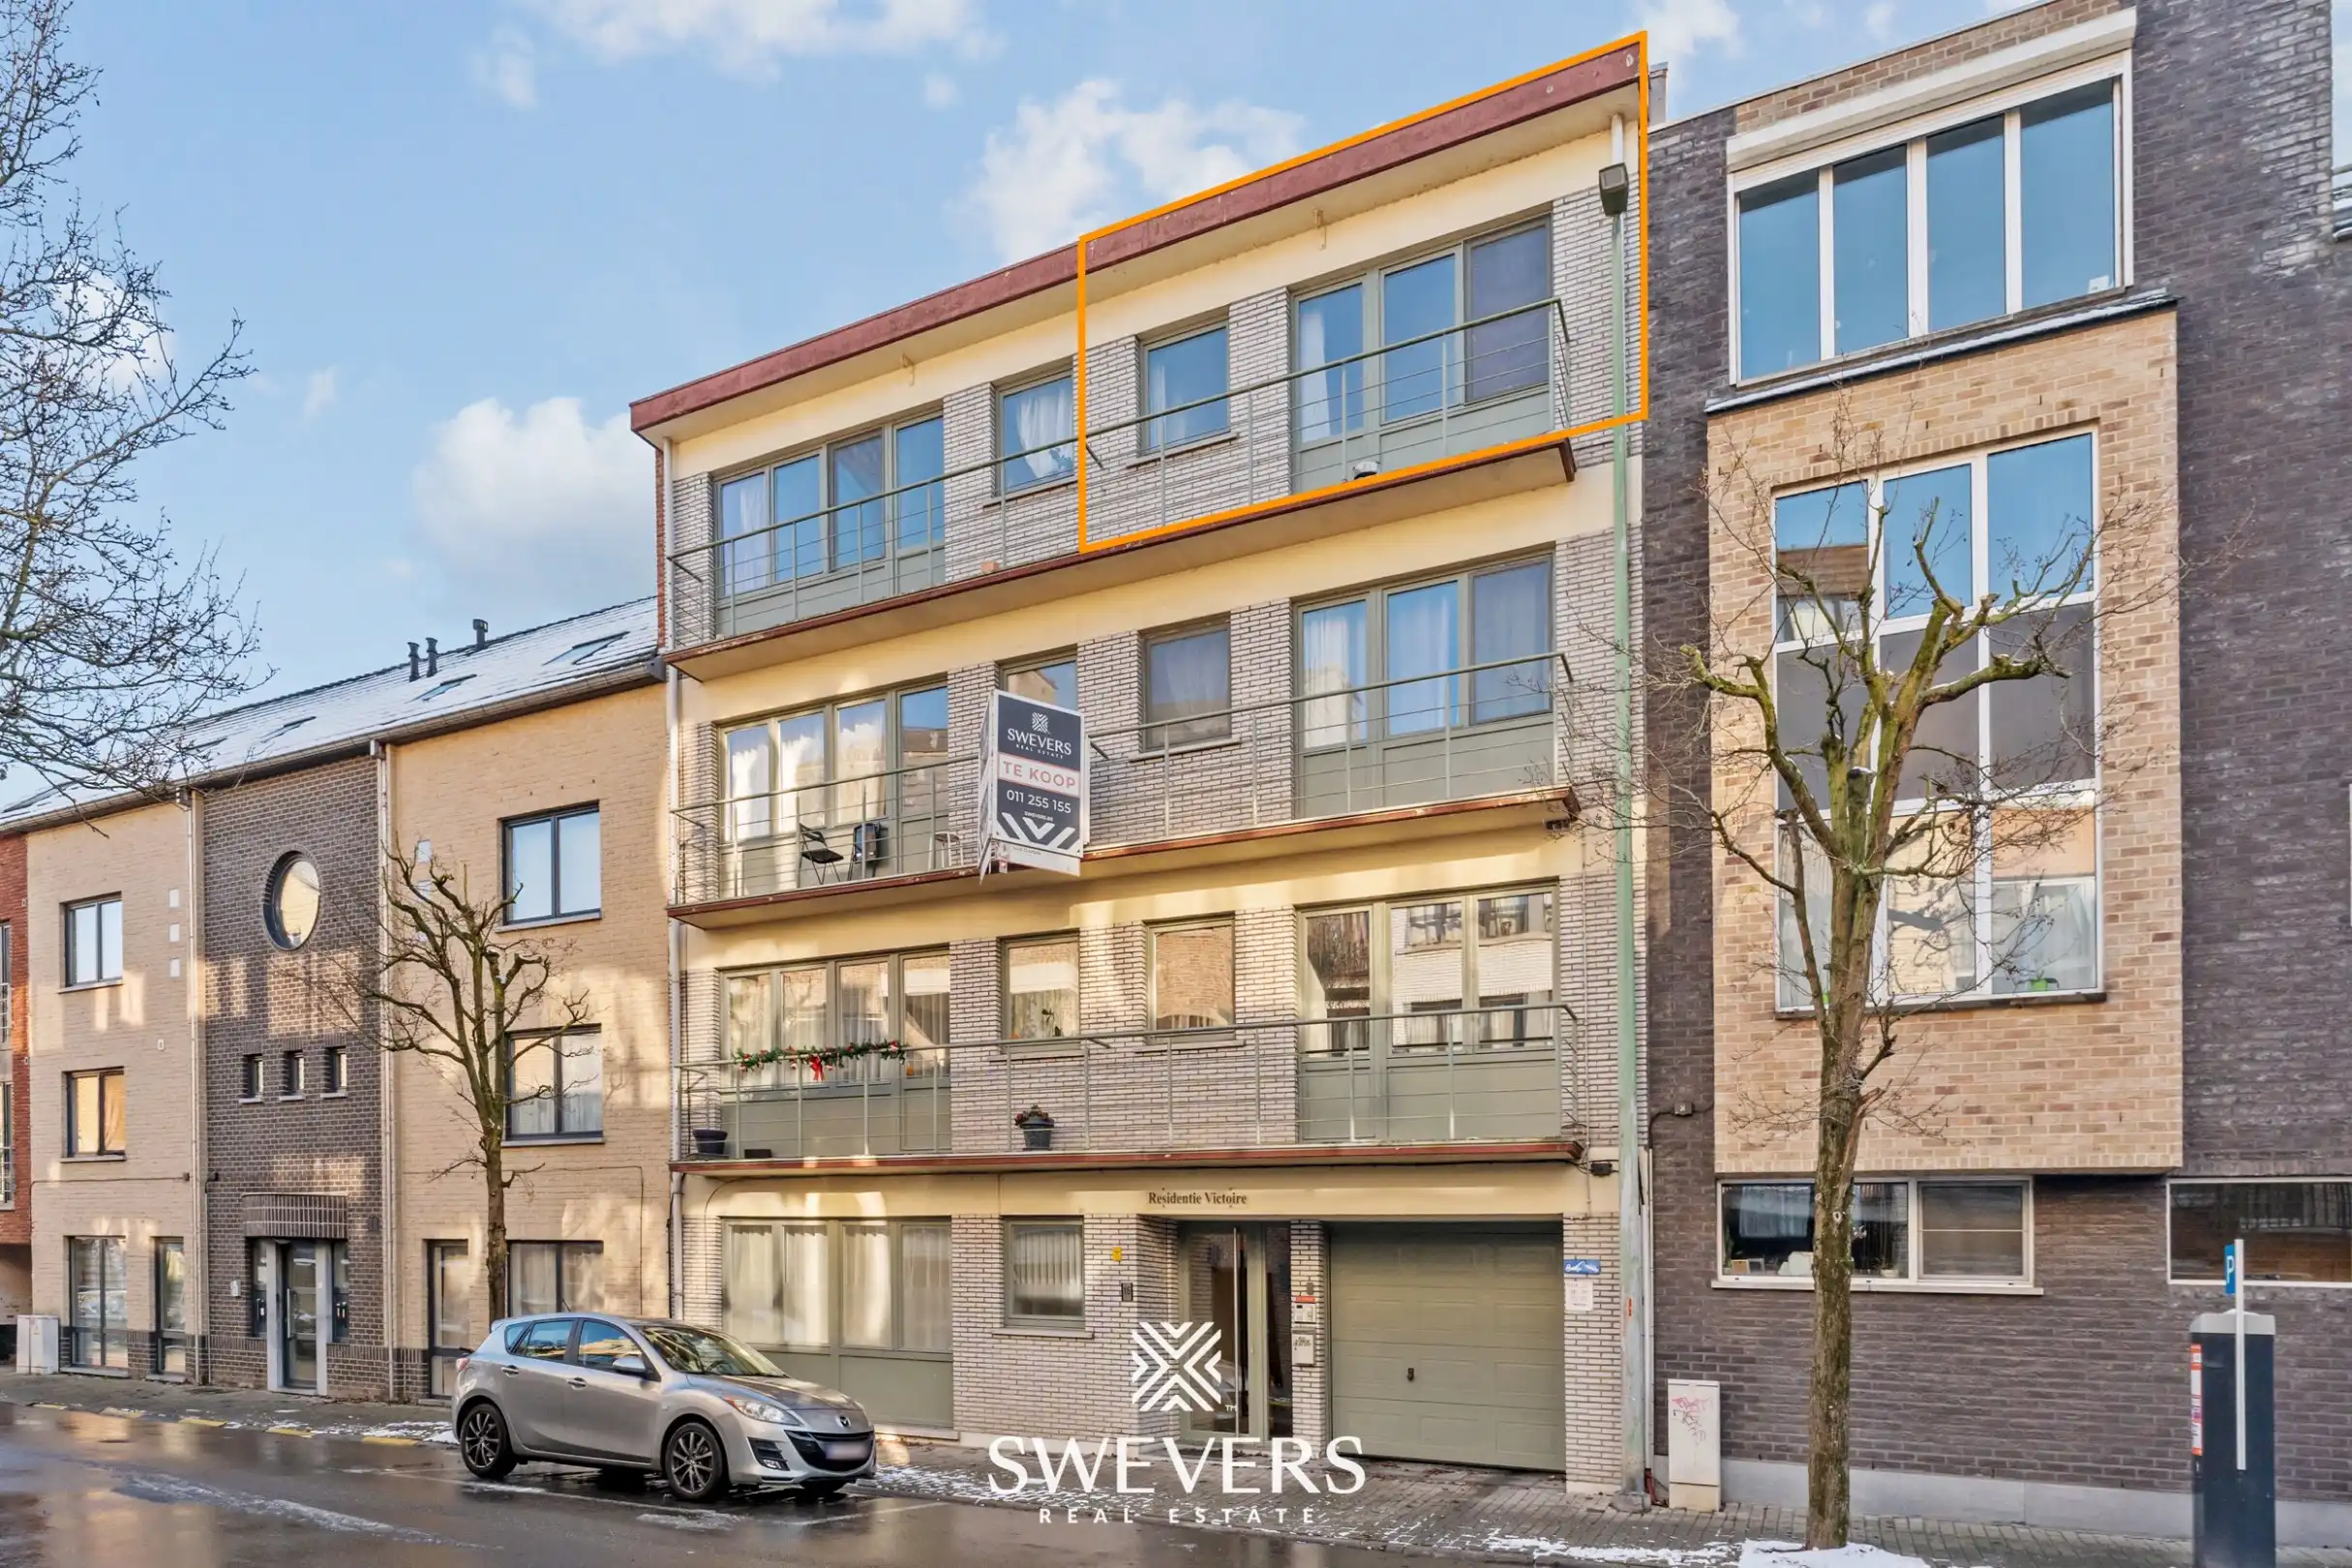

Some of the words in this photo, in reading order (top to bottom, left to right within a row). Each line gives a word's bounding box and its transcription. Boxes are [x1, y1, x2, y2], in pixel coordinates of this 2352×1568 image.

[1008, 728, 1072, 755] SWEVERS
[1016, 743, 1034, 752] REAL
[1003, 761, 1023, 777] TE
[1029, 768, 1076, 789] KOOP
[1007, 789, 1024, 803] 011
[1028, 794, 1049, 809] 255
[1052, 799, 1071, 814] 155
[1148, 1191, 1202, 1205] Residentie
[1205, 1191, 1248, 1205] Victoire
